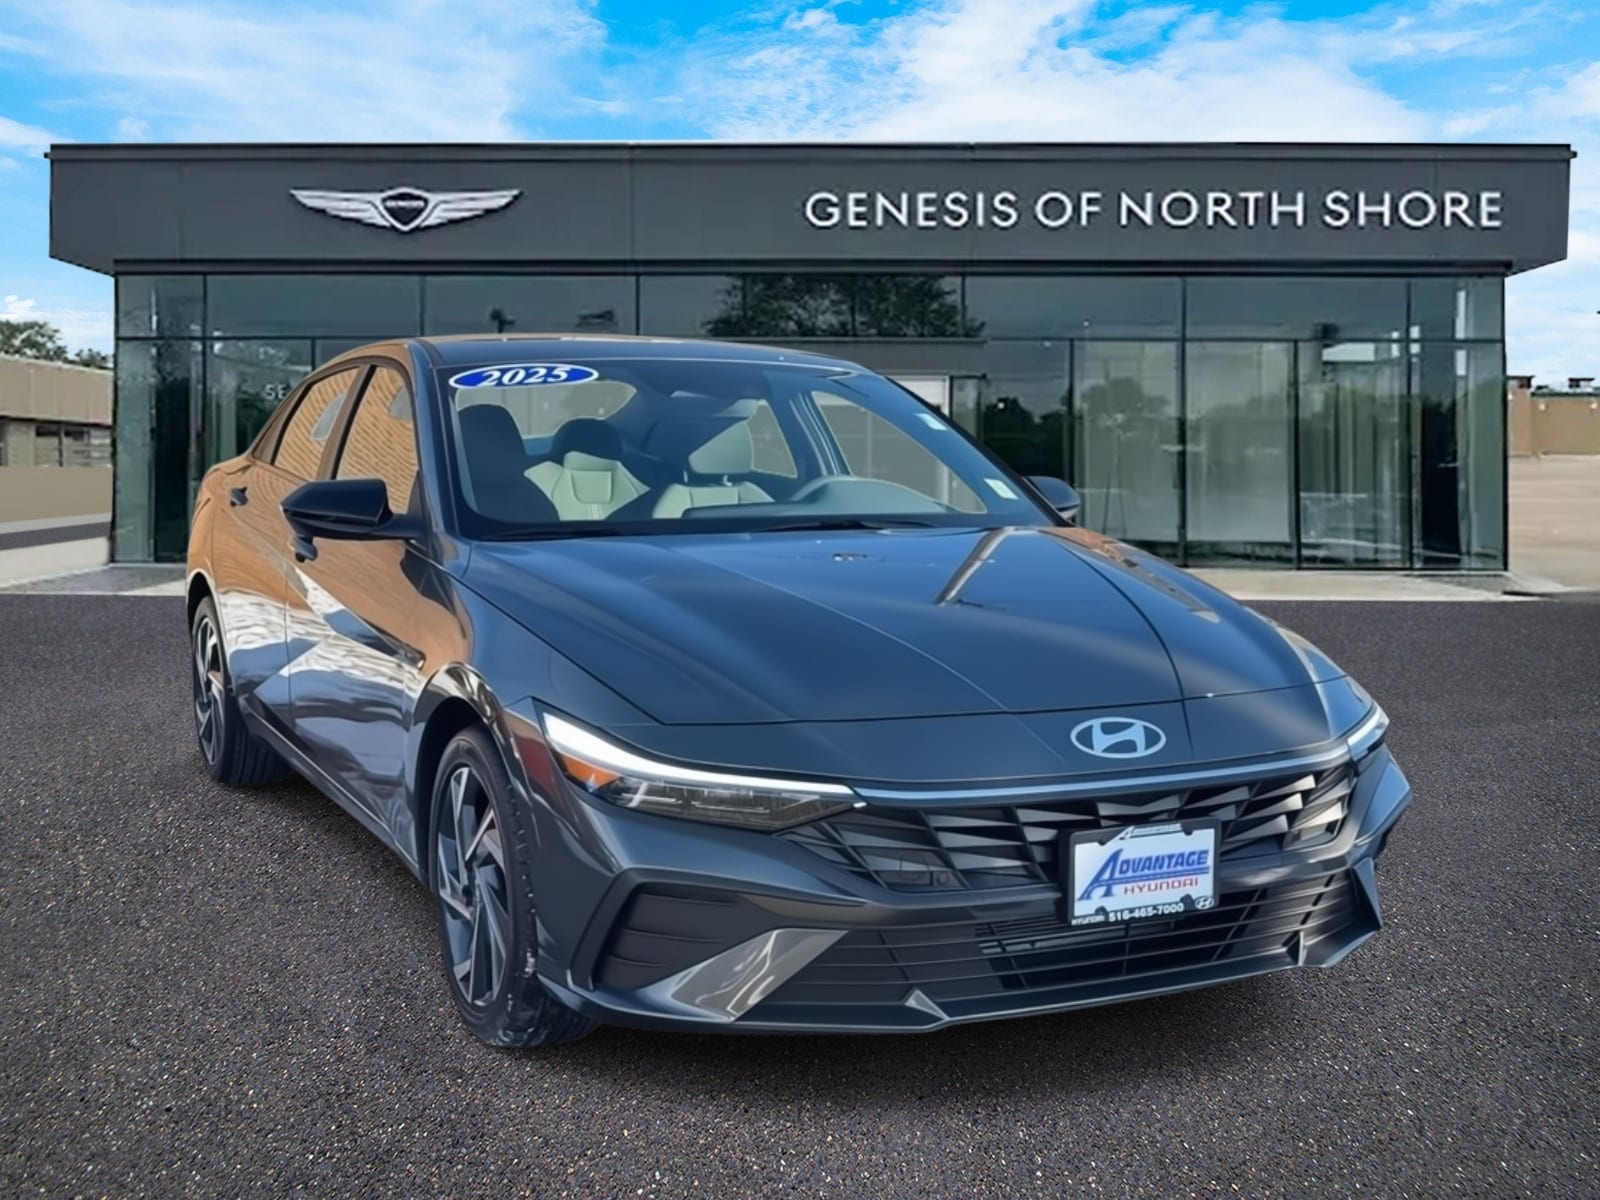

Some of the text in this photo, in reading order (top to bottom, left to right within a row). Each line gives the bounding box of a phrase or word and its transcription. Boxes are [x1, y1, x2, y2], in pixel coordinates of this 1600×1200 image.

[804, 190, 1503, 227] GENESIS OF NORTH SHORE
[476, 367, 571, 387] 2025
[1077, 849, 1209, 901] ADVANTAGE
[1123, 877, 1198, 895] HYUNDAI
